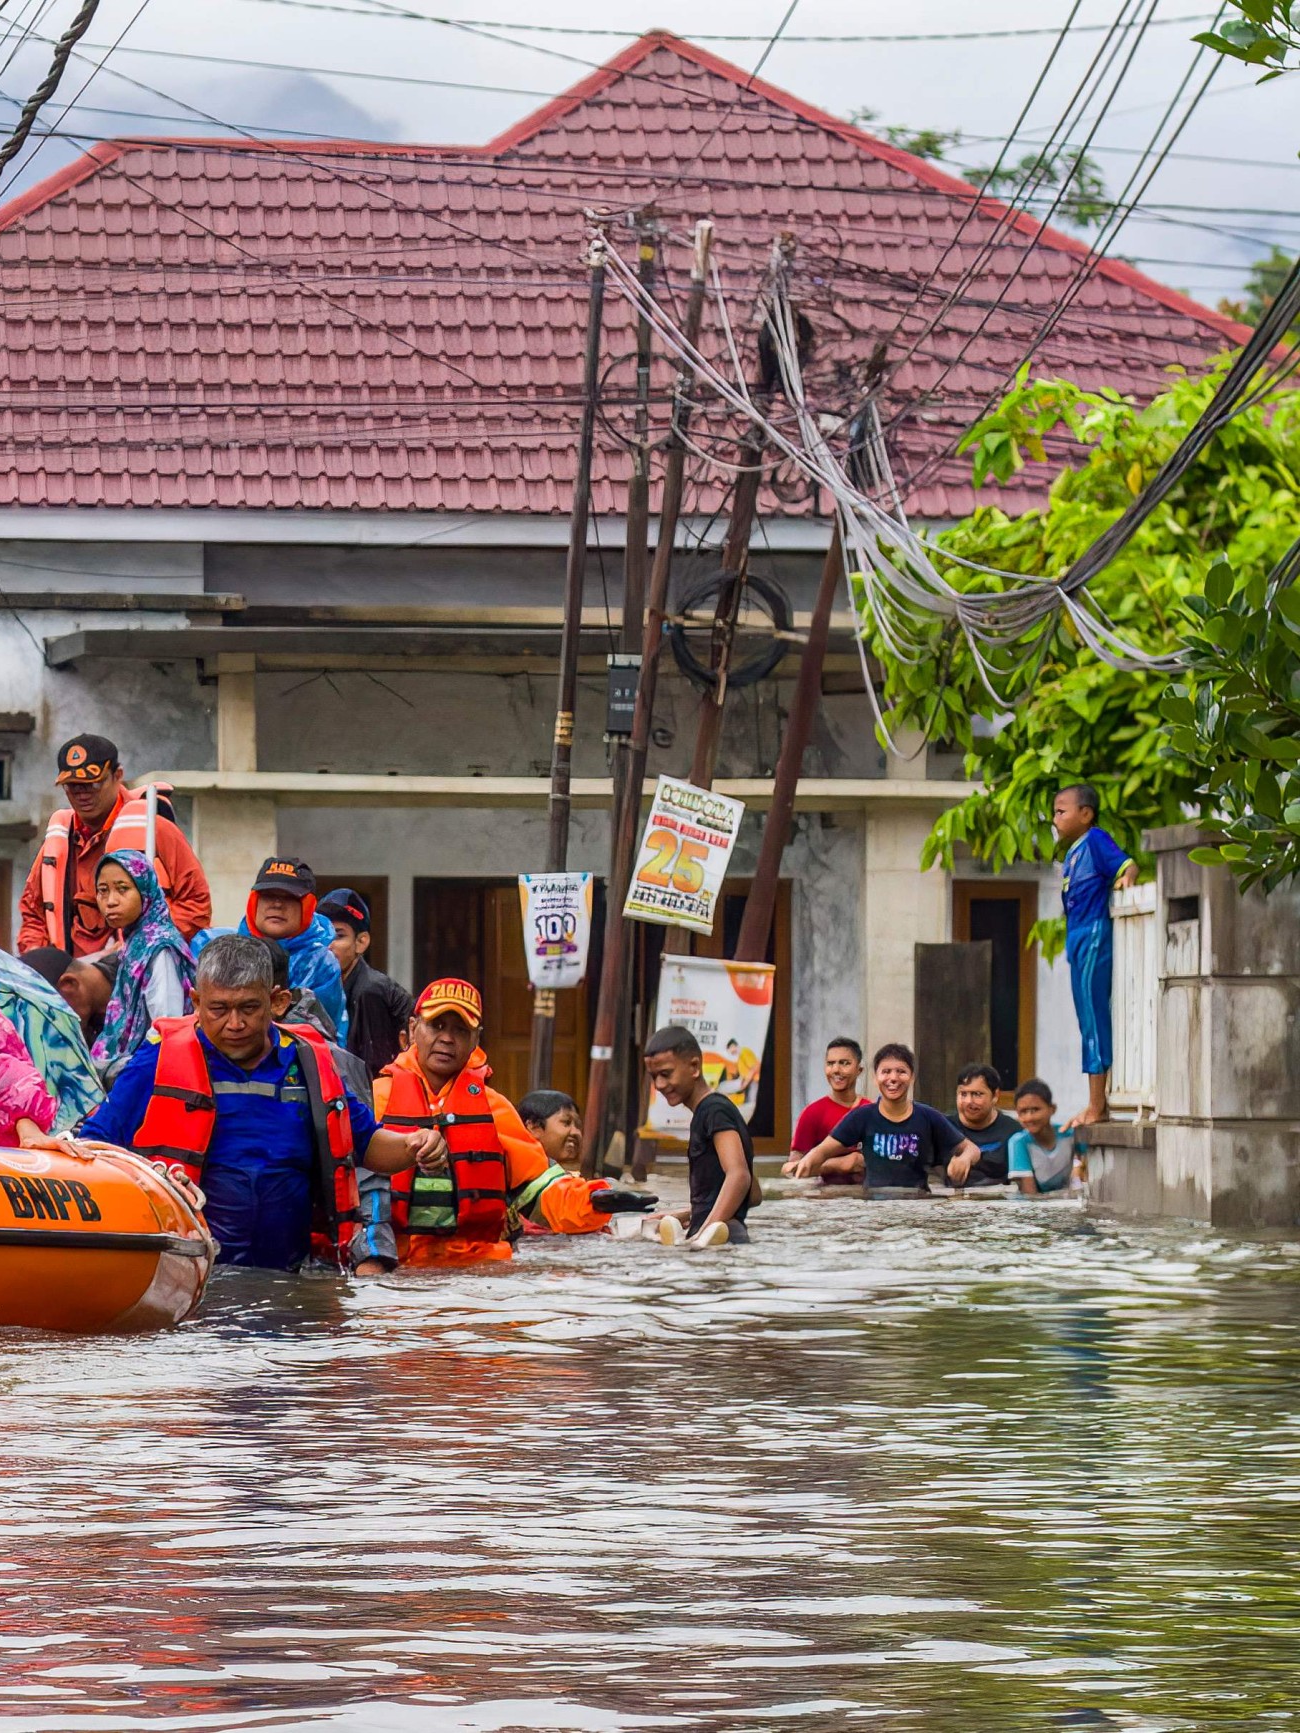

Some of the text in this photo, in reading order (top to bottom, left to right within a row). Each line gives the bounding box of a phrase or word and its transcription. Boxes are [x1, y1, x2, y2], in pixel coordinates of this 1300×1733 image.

[637, 829, 709, 894] 25
[535, 912, 576, 944] 100
[430, 983, 478, 1006] TAGANA
